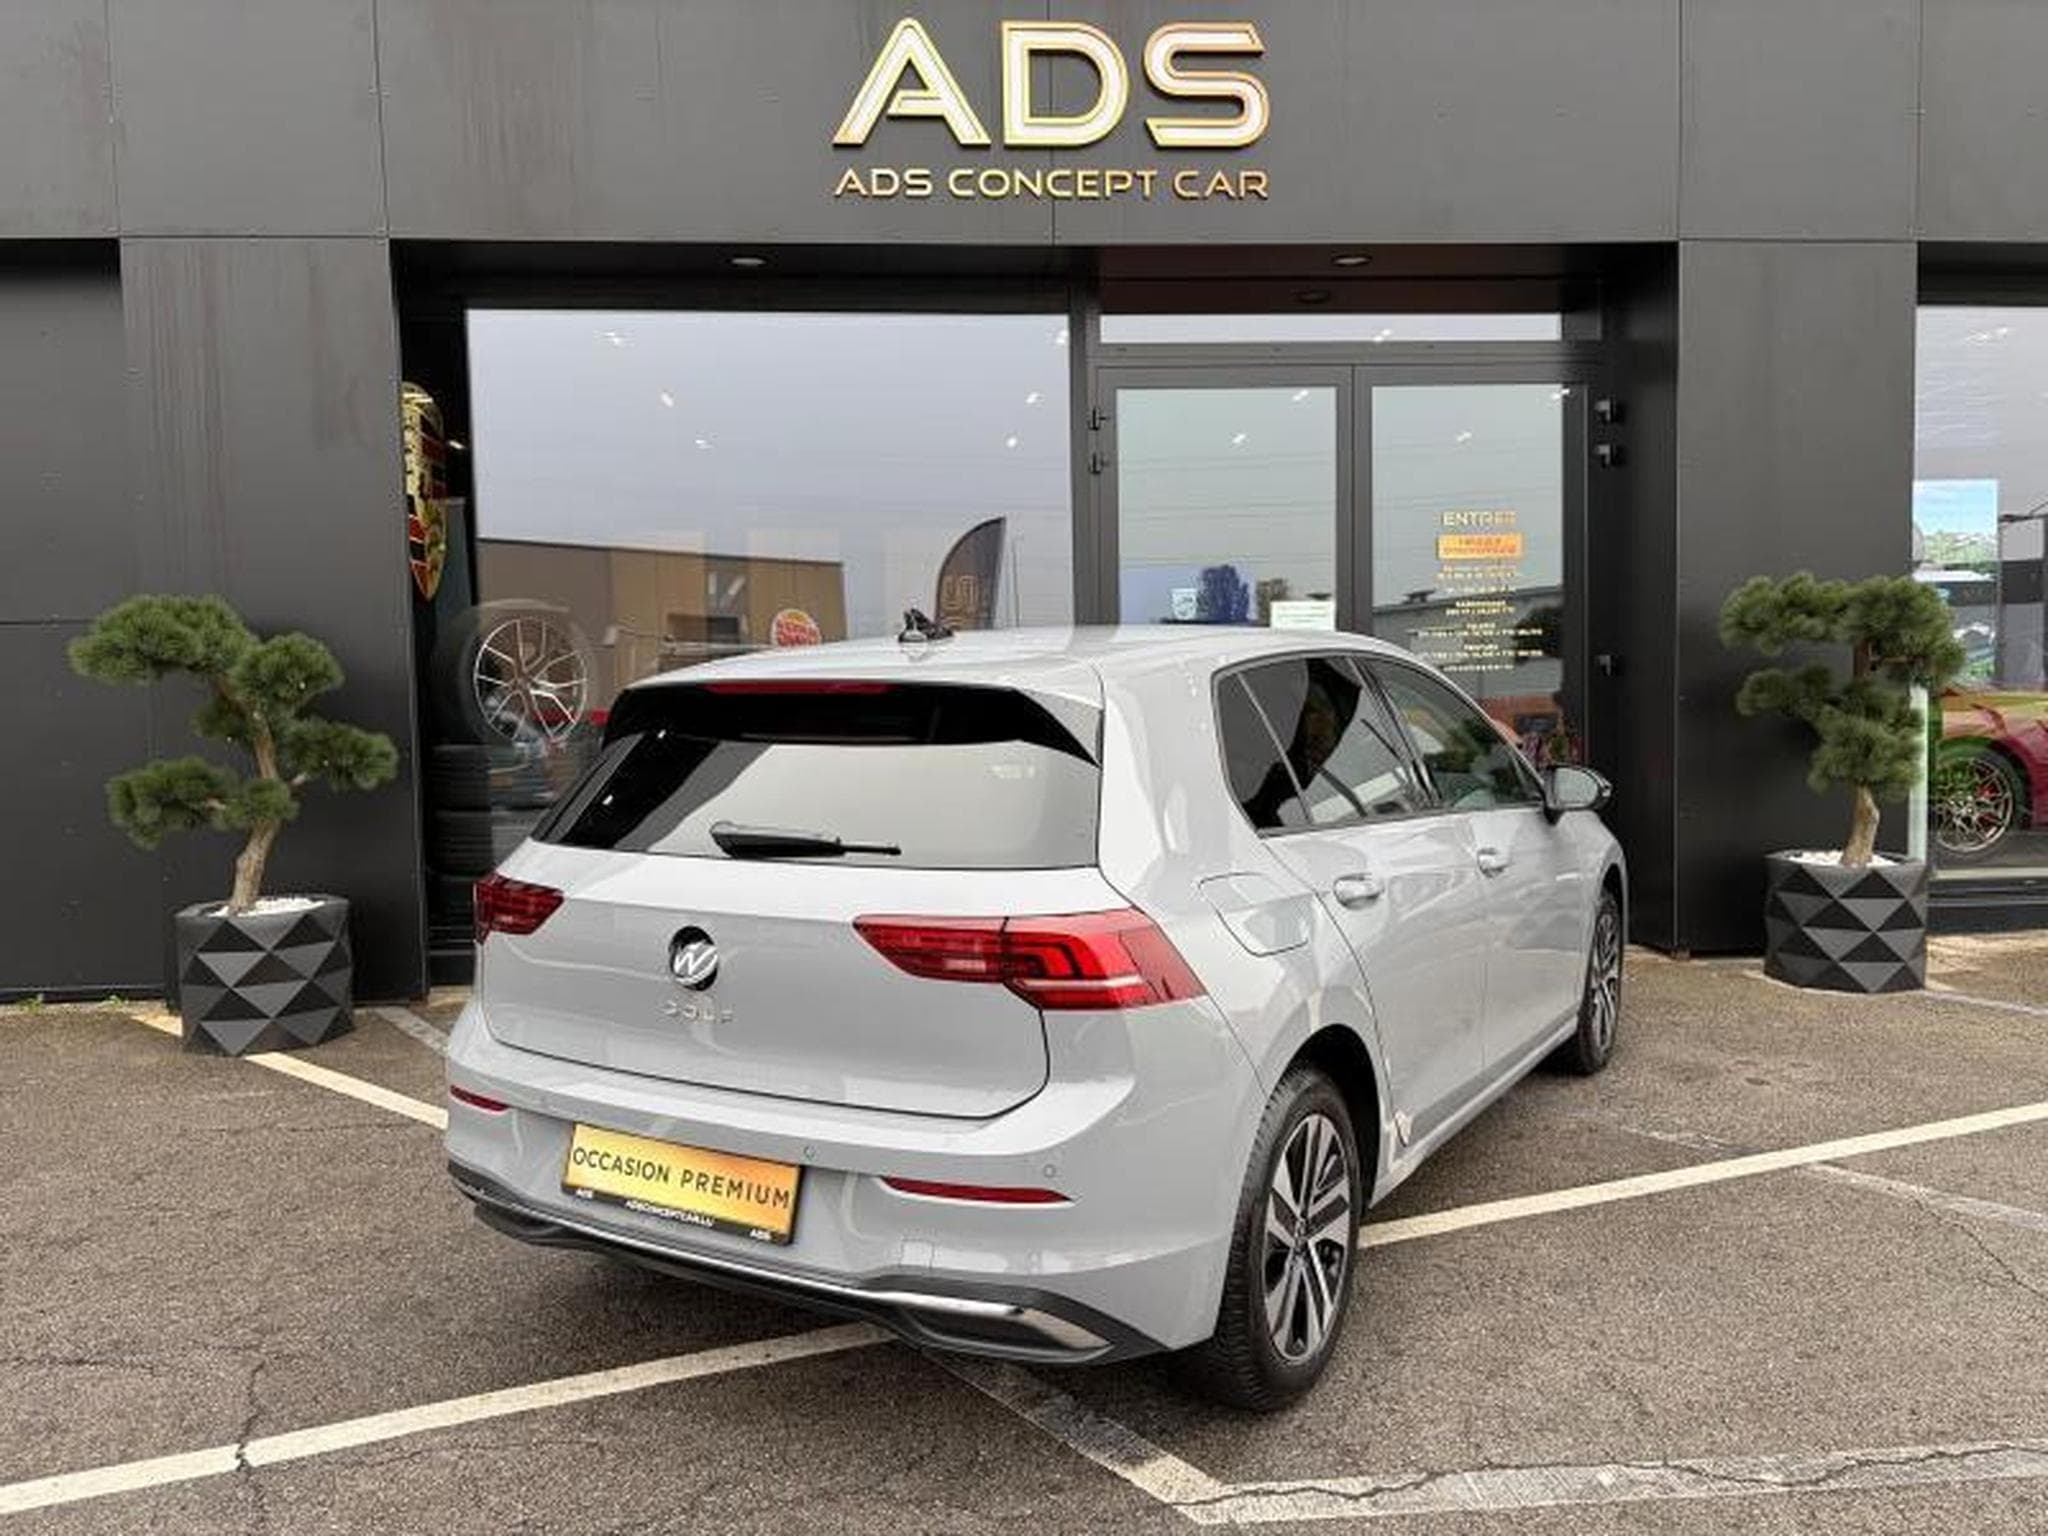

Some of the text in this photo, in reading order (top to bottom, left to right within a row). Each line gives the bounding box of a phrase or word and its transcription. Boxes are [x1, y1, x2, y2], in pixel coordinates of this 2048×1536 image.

[833, 17, 1270, 148] ADS
[834, 168, 1269, 199] ADS CONCEPT CAR
[573, 1148, 790, 1209] OCCASION PREMIUM
